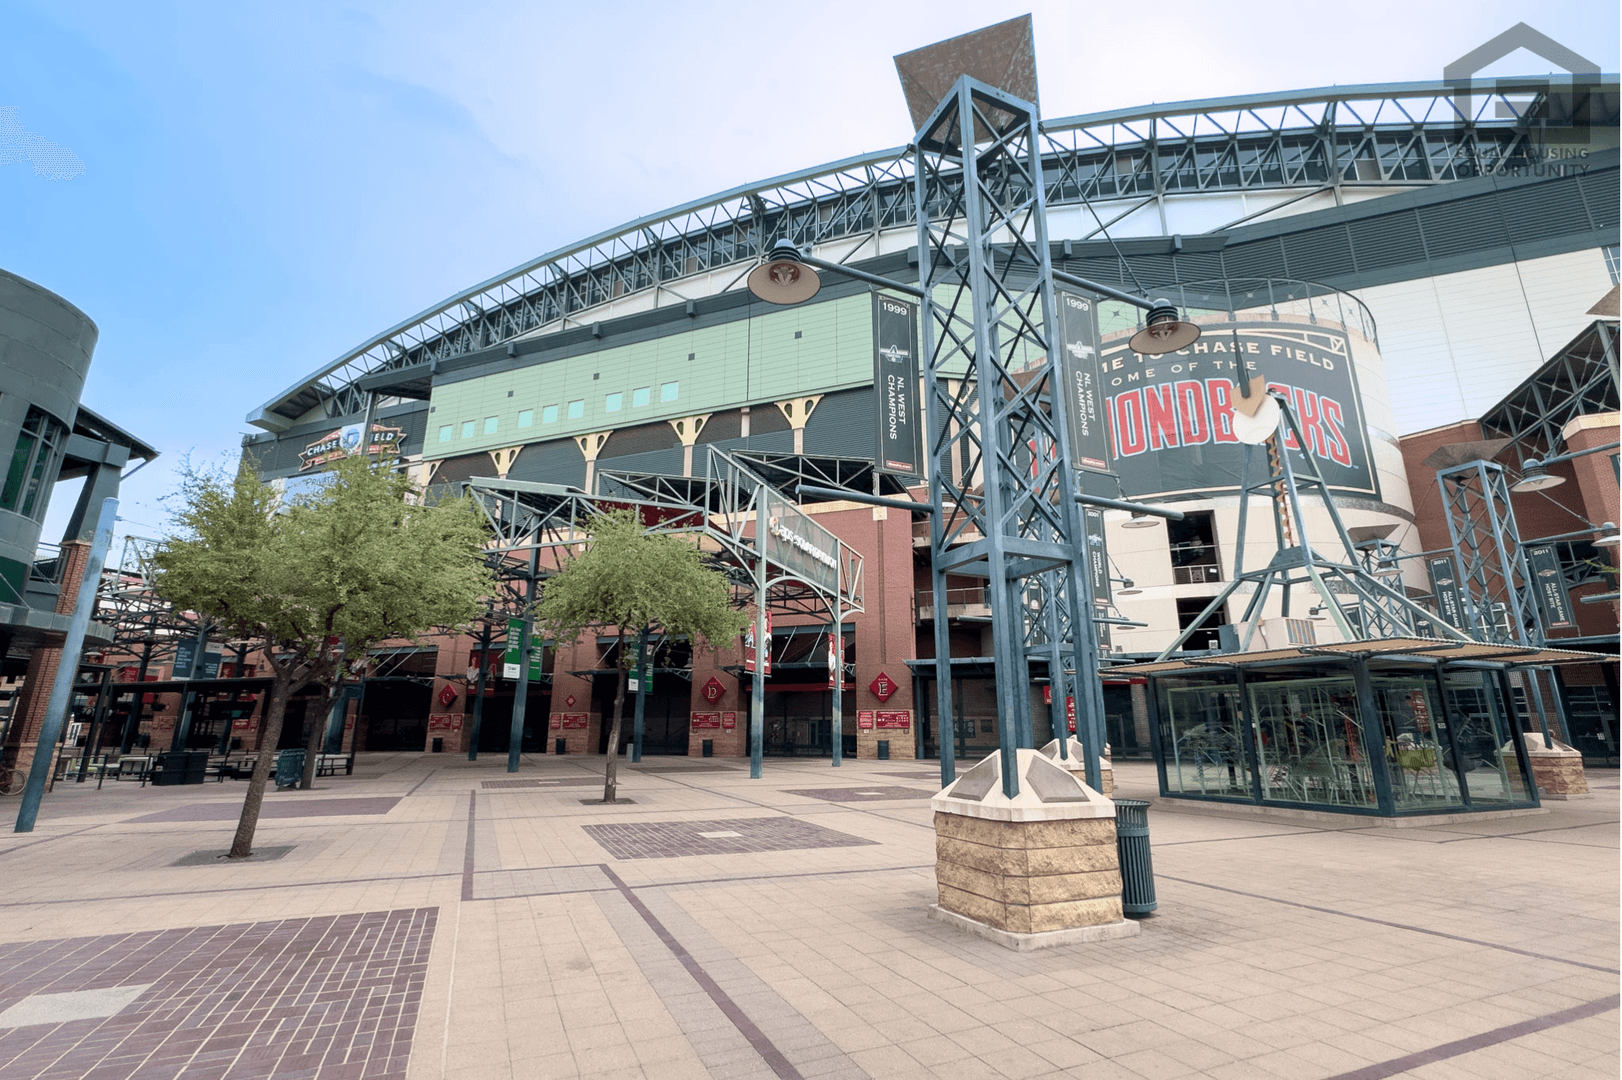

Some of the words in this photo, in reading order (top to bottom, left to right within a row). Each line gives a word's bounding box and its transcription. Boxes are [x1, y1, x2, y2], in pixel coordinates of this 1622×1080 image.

[882, 301, 908, 316] 1999
[1066, 297, 1089, 312] 1999
[1270, 344, 1335, 371] FIELD
[897, 376, 904, 392] NL
[1084, 372, 1091, 388] NL
[1111, 367, 1156, 387] OME
[1170, 361, 1199, 374] OF
[887, 374, 897, 440] CHAMPIONS
[898, 395, 906, 425] WEST
[1075, 370, 1089, 437] CHAMPIONS
[1086, 389, 1095, 422] WEST
[307, 439, 338, 456] CHASE
[878, 682, 889, 696] E
